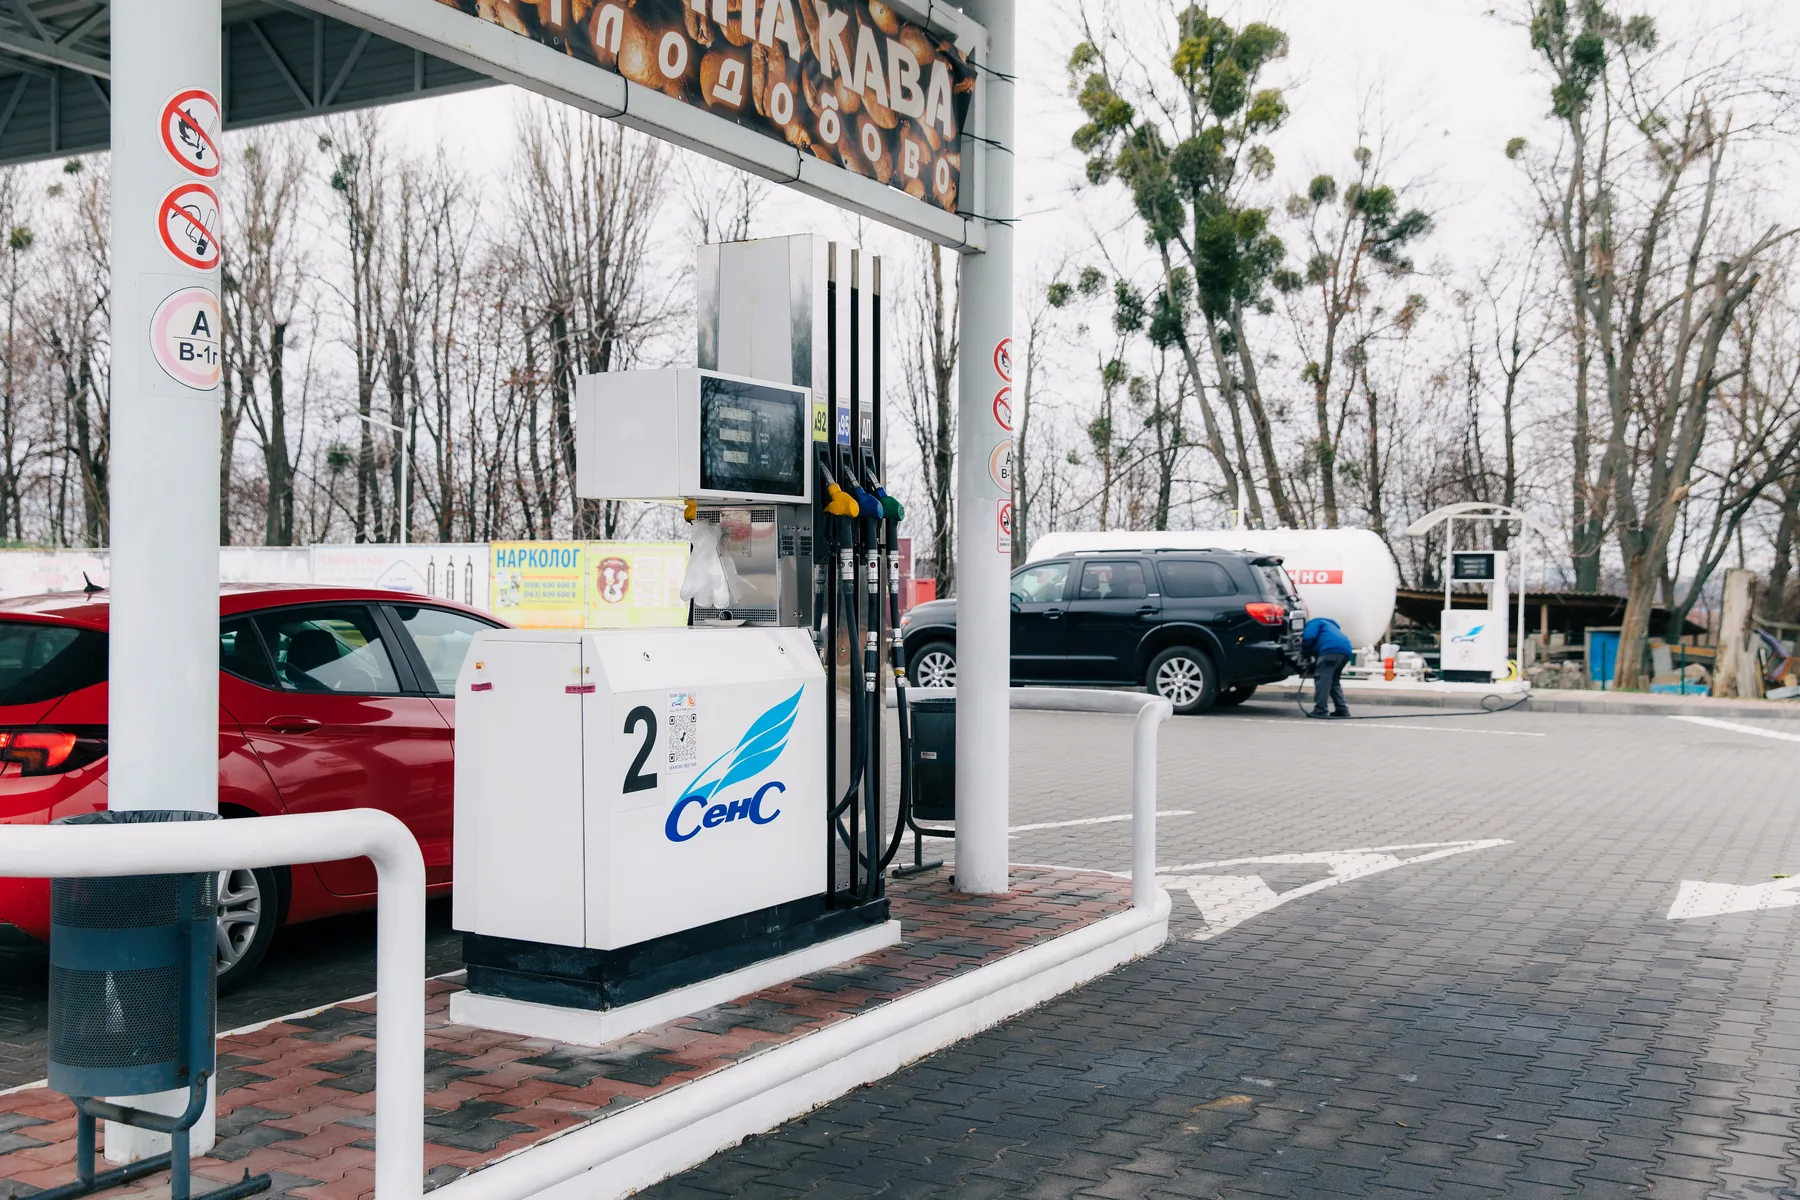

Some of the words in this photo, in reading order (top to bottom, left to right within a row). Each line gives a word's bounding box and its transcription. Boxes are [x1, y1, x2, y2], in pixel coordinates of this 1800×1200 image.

[815, 0, 954, 141] КАВА
[496, 549, 580, 568] НАРКОЛОГ
[623, 705, 658, 794] 2
